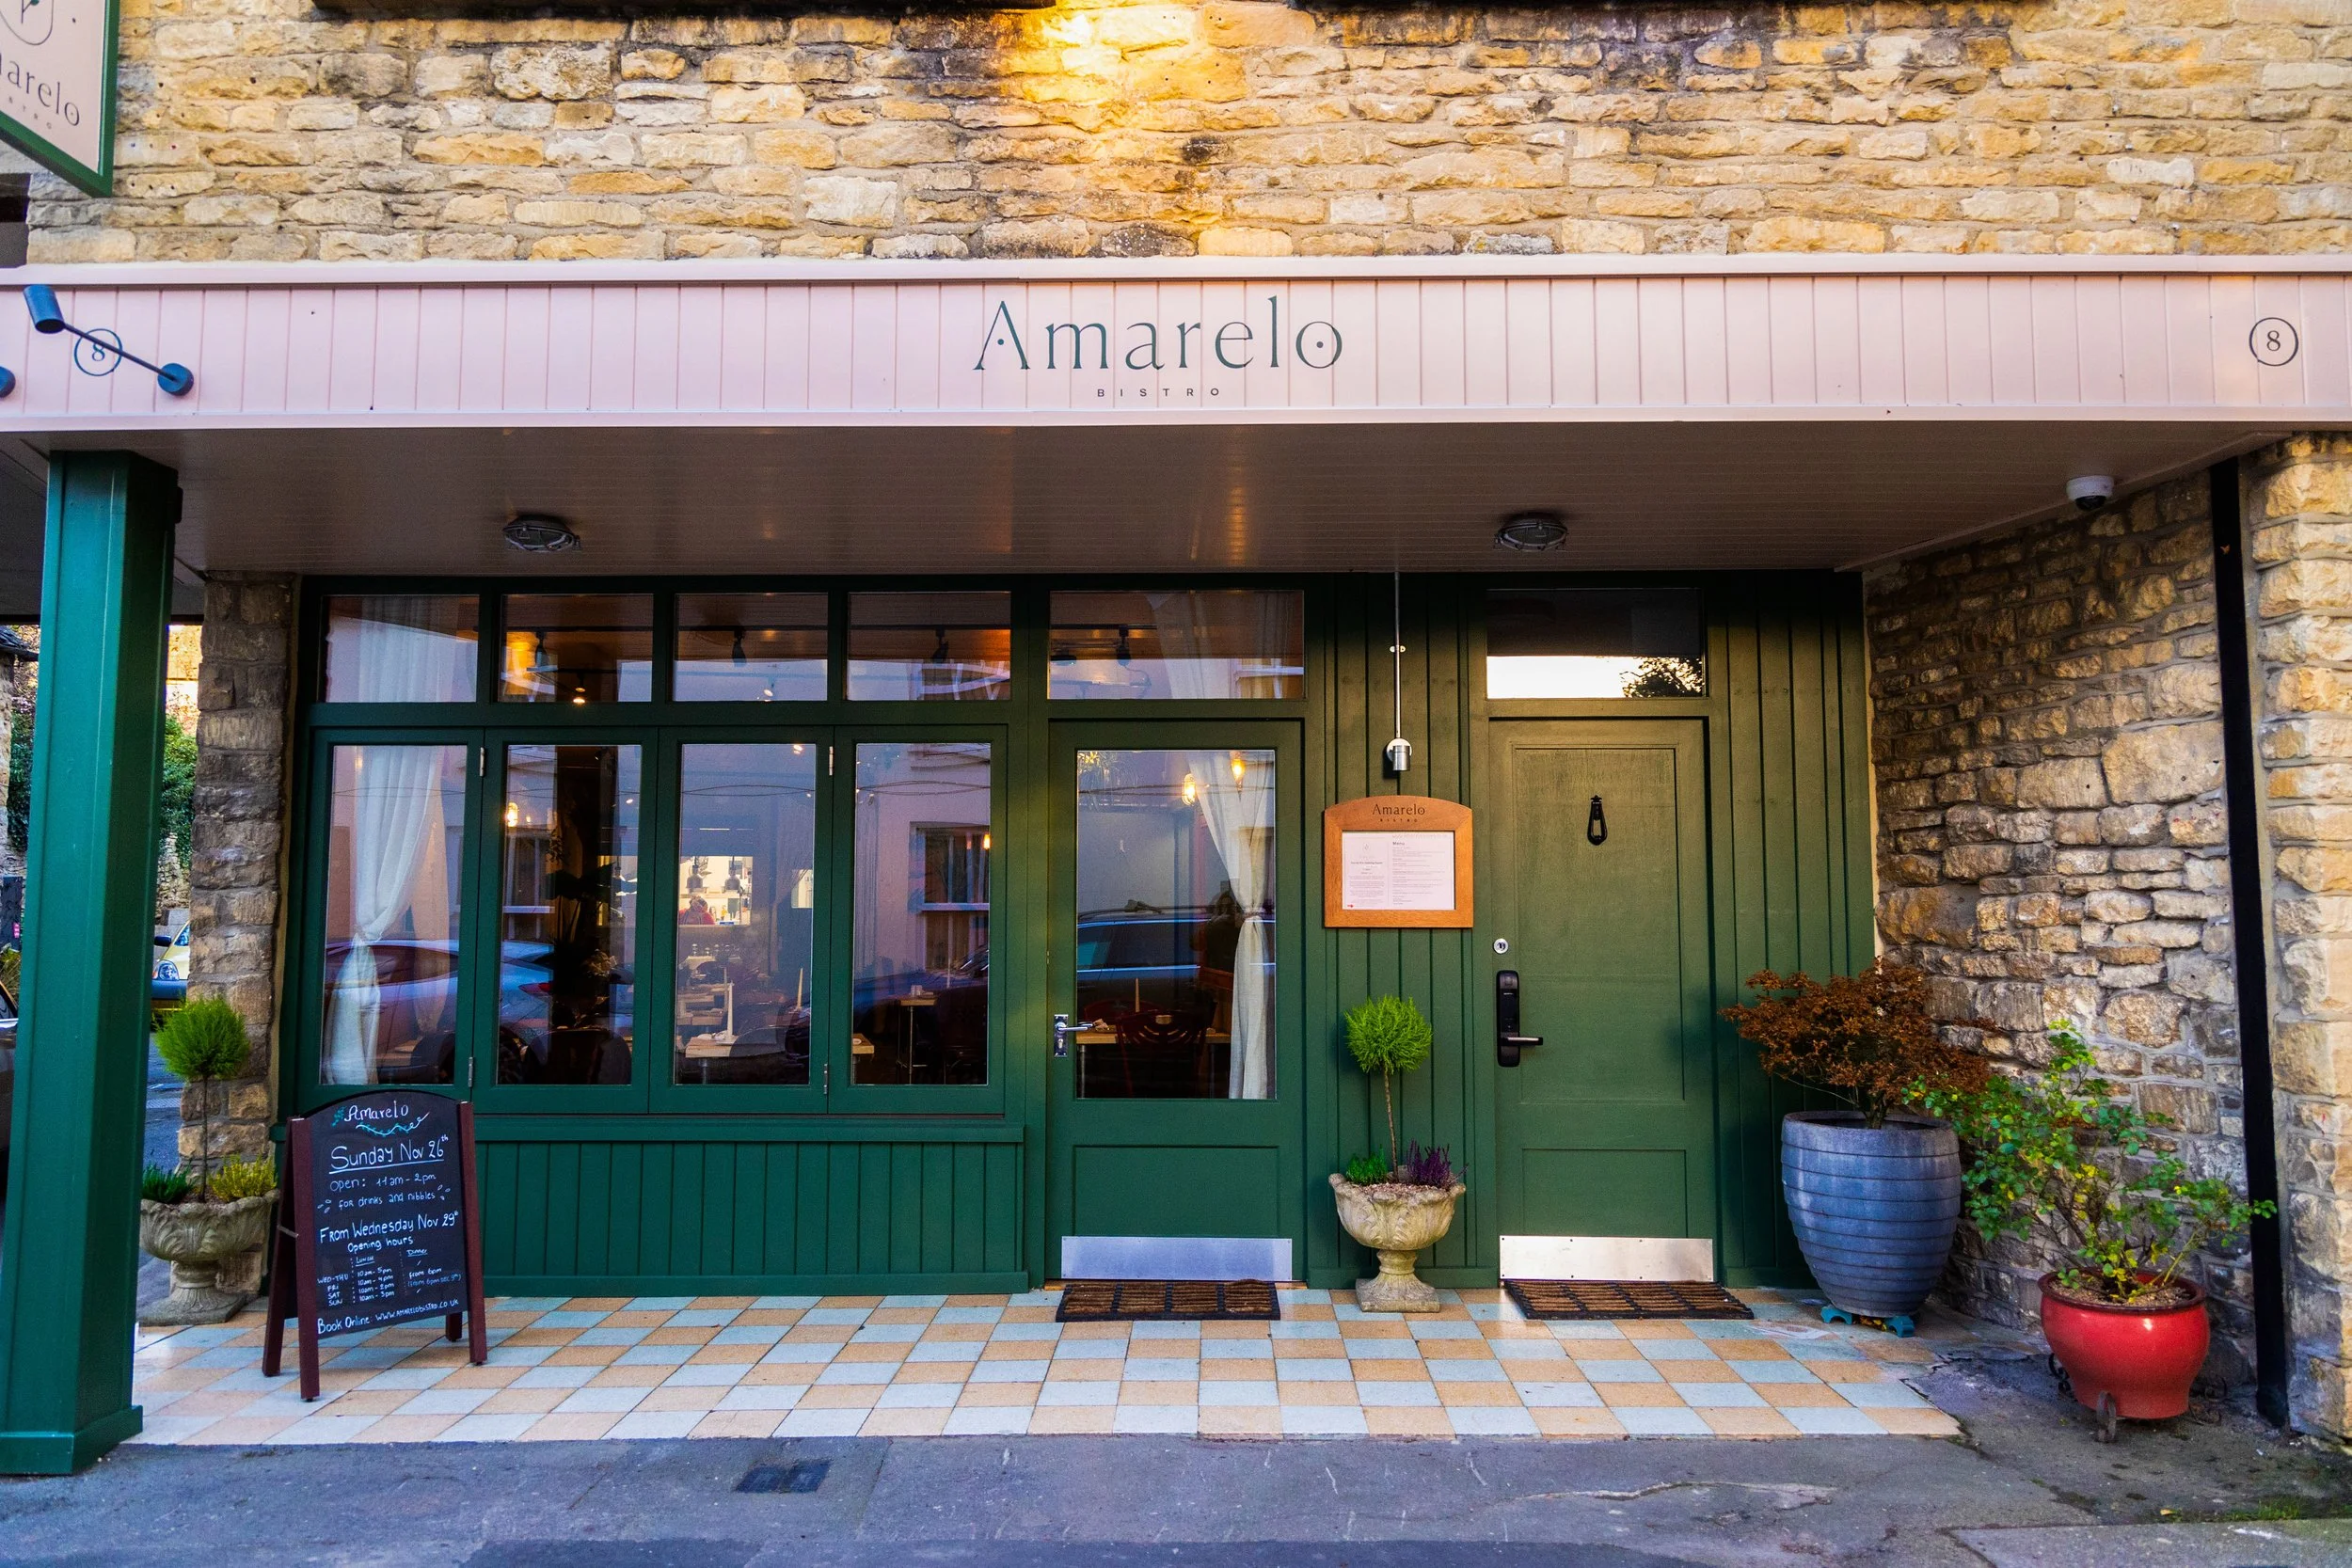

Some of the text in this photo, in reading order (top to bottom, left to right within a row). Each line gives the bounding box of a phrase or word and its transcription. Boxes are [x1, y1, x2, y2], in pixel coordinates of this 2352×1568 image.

[0, 53, 80, 126] arelo
[972, 294, 1343, 371] Amarelo
[2266, 330, 2280, 352] 8
[92, 341, 105, 362] 8
[1097, 388, 1220, 398] BISTRO
[1372, 803, 1425, 816] Amarelo
[343, 1101, 409, 1121] Amarelo
[331, 1146, 393, 1170] Sunday
[401, 1139, 424, 1161] Nov
[414, 1173, 437, 1185] 2pm
[358, 1196, 383, 1208] drinks
[389, 1194, 405, 1203] and
[408, 1192, 436, 1201] nibbles
[352, 1220, 414, 1239] Wednesday
[418, 1213, 438, 1229] Nov
[348, 1236, 414, 1254] Opening hours
[318, 1318, 343, 1335] Book
